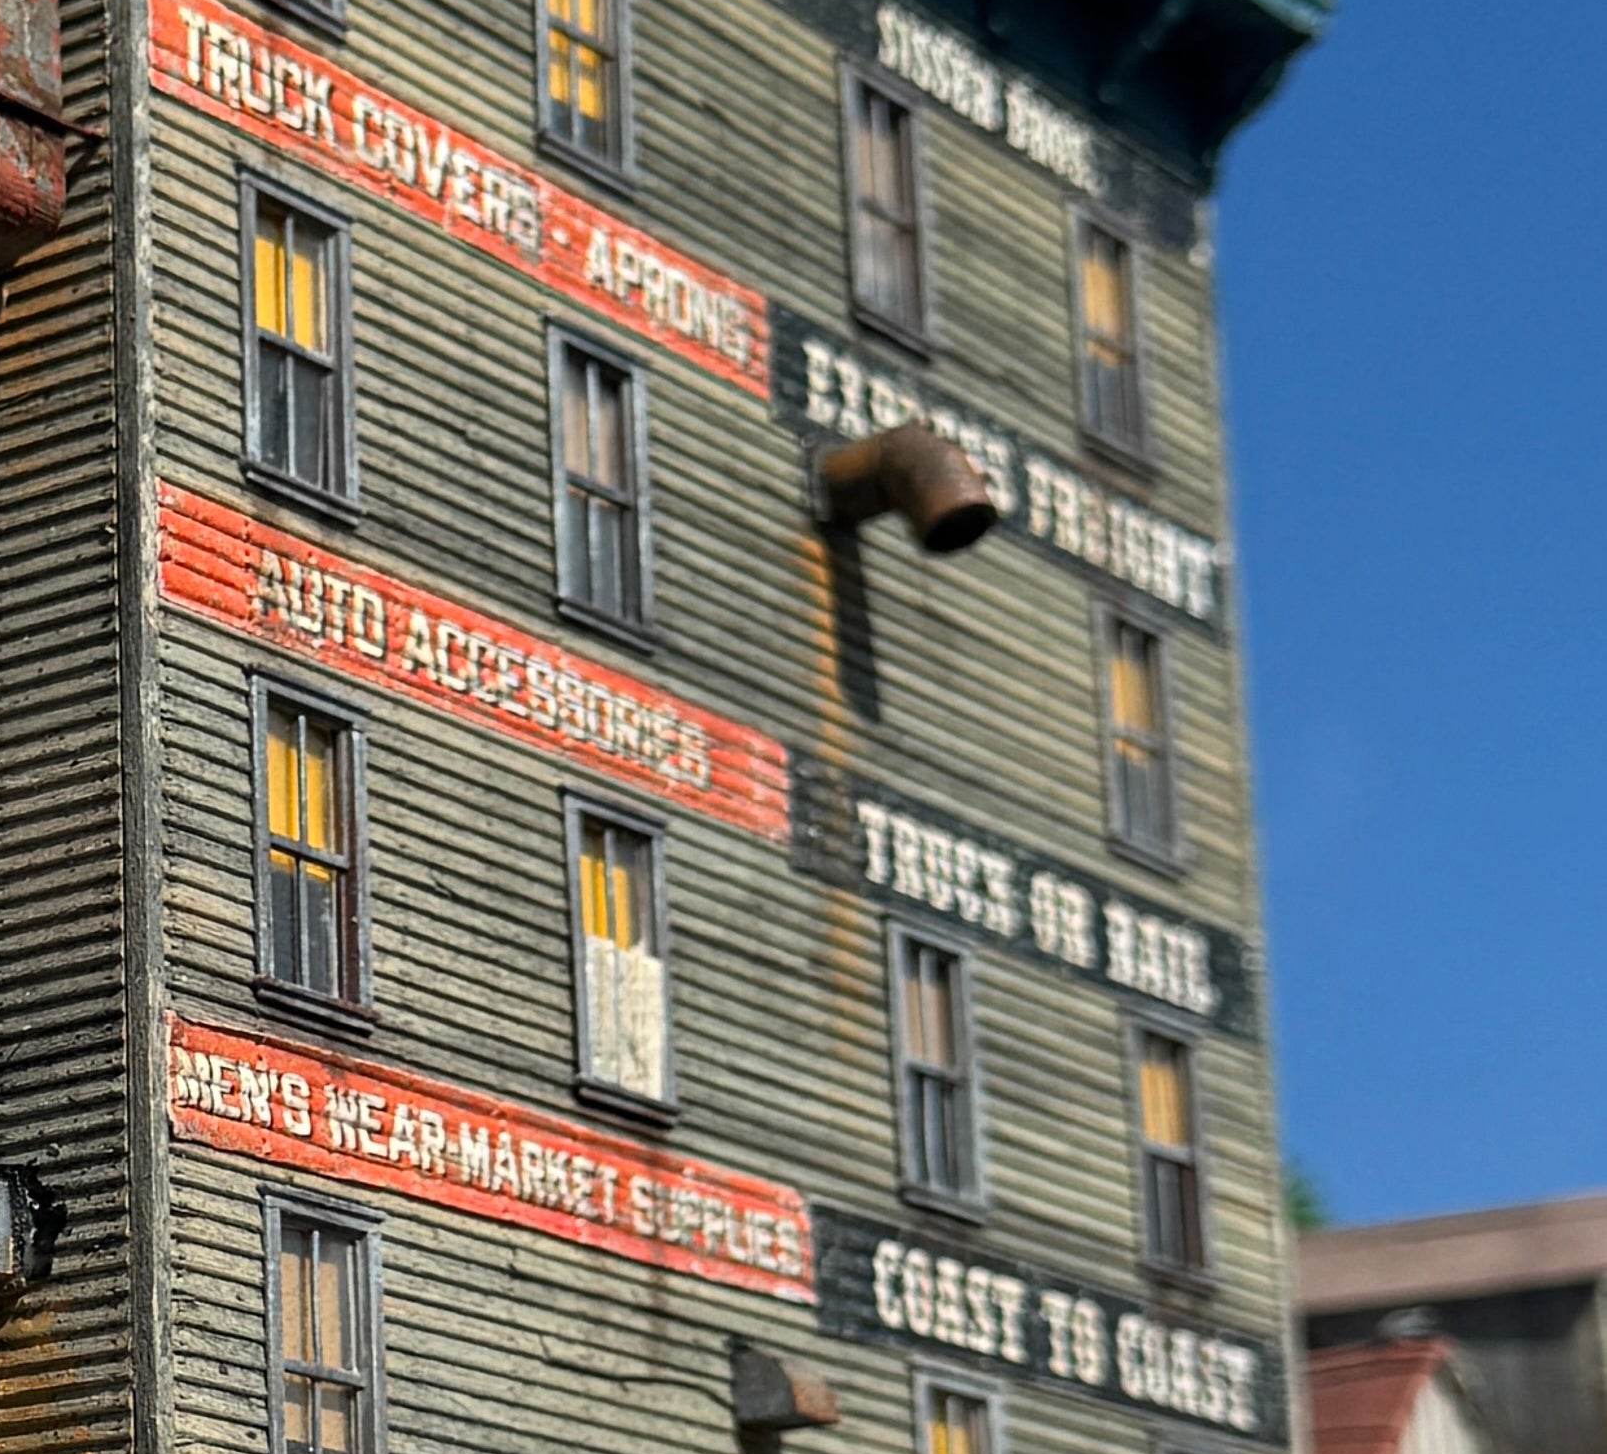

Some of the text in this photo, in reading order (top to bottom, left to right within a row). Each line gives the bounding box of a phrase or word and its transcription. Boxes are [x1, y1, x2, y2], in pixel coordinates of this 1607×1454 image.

[180, 6, 750, 364] TRUCK COVERS APRONS
[1025, 455, 1216, 620] FREIGHT
[255, 549, 710, 791] AUTO ACCESSORIES
[174, 1047, 312, 1137] MEN'S
[630, 1176, 803, 1275] SUPPLIES
[872, 1239, 1261, 1433] COAST TO COAST
